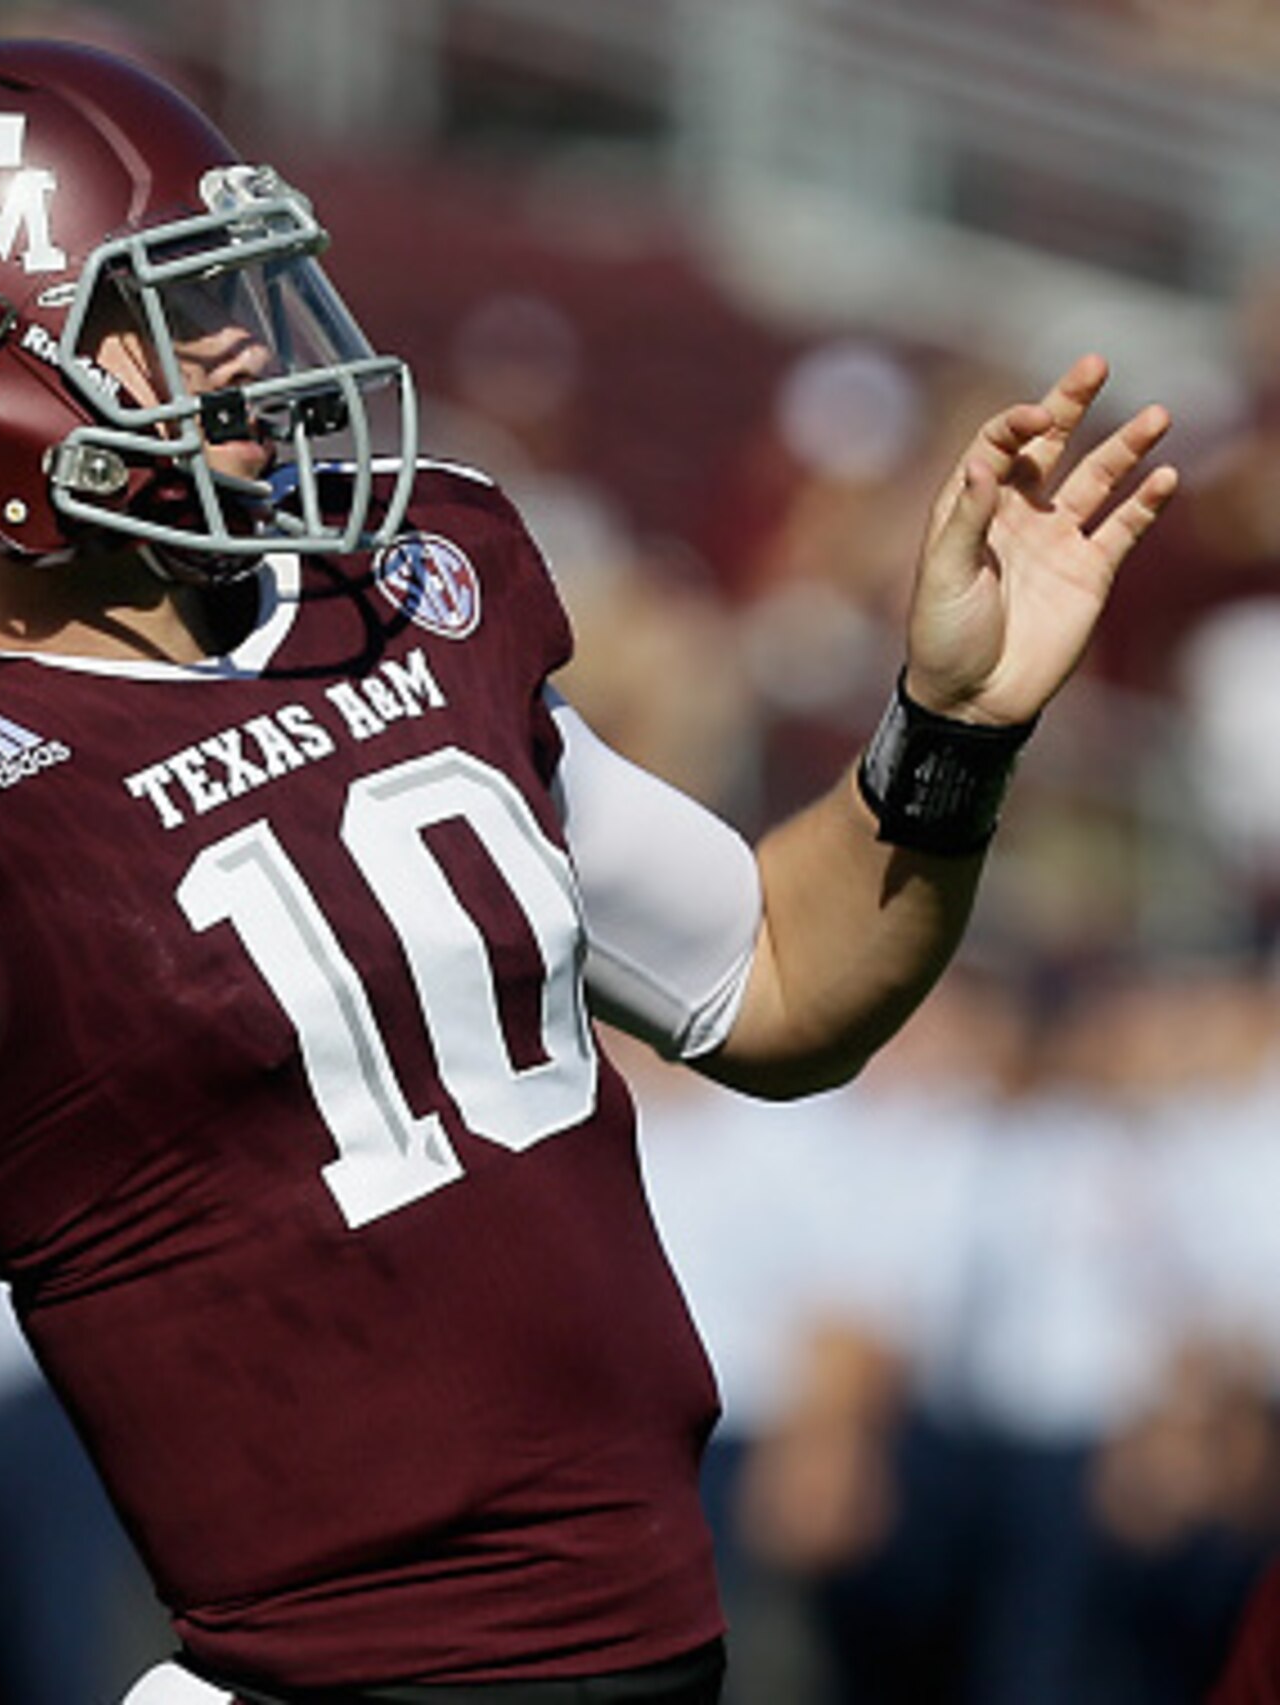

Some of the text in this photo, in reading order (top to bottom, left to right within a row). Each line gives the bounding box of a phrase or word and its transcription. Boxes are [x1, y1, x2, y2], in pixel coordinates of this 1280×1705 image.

[123, 647, 447, 830] TEXAS A&M
[176, 746, 599, 1230] 10
